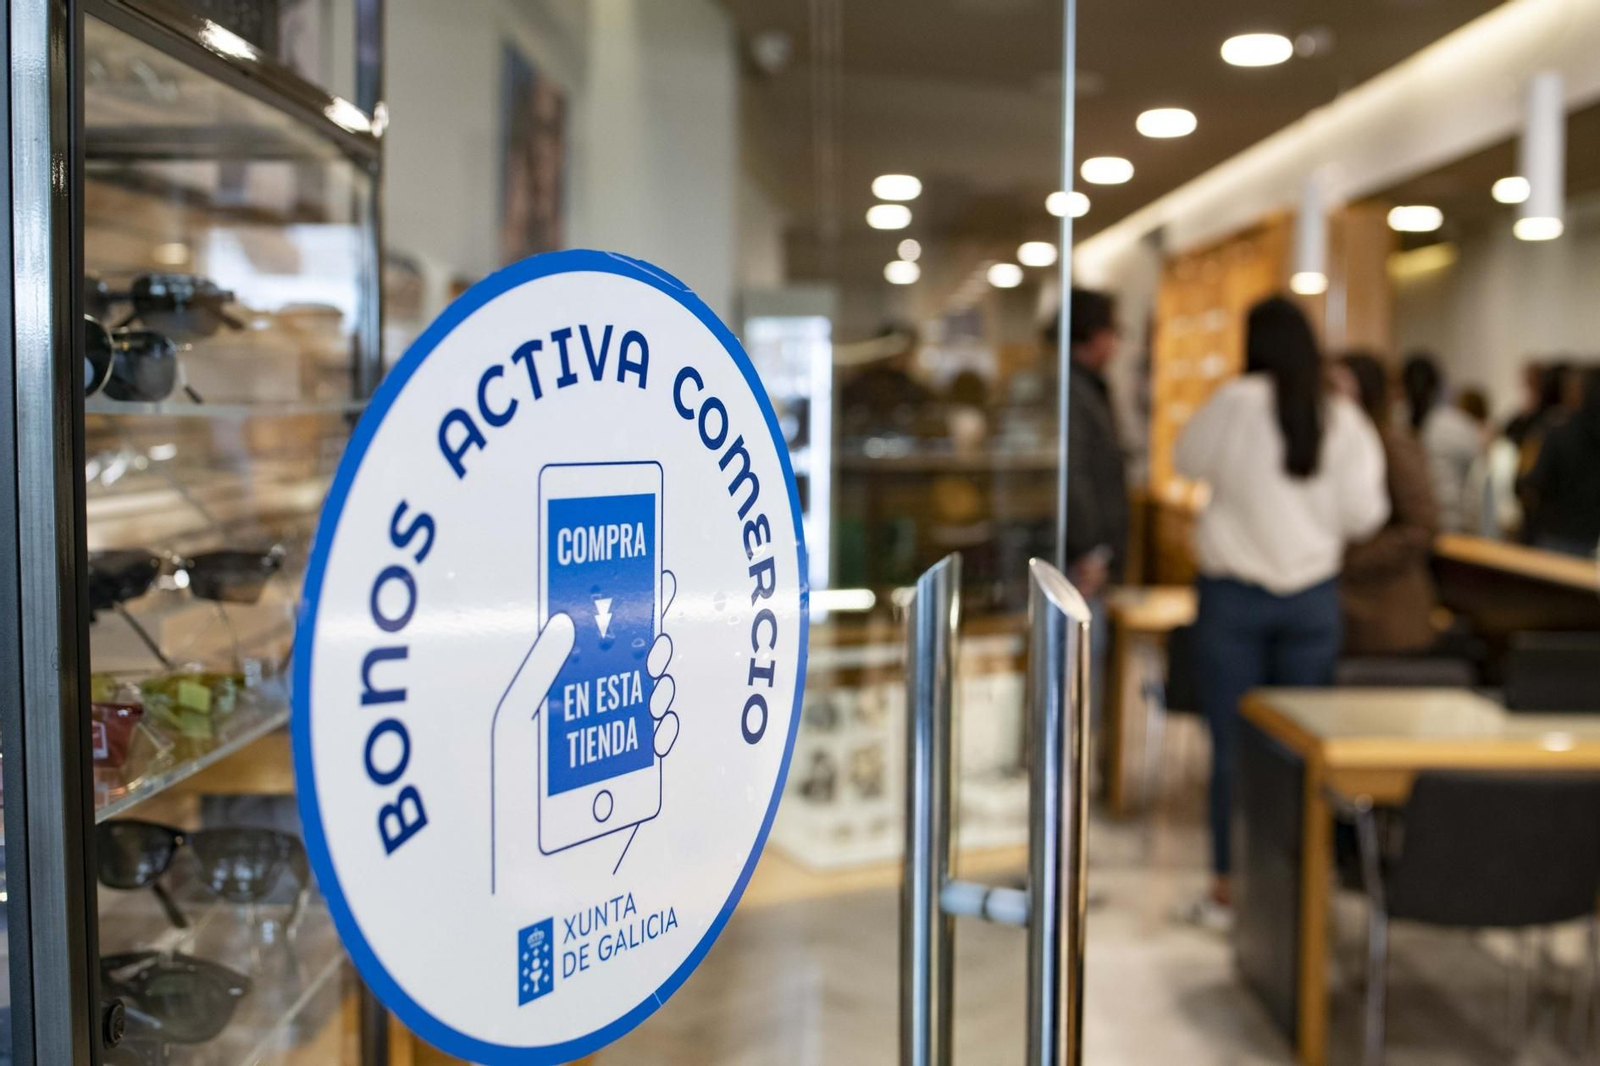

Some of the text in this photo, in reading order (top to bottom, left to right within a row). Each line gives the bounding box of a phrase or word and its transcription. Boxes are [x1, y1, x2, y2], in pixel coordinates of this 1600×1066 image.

[437, 324, 650, 480] ACTIVA
[557, 522, 647, 566] COMPRA
[563, 670, 643, 722] EN ESTA
[566, 717, 638, 769] TIENDA
[562, 906, 678, 979] DE GALICIA
[563, 892, 637, 944] XUNTA
